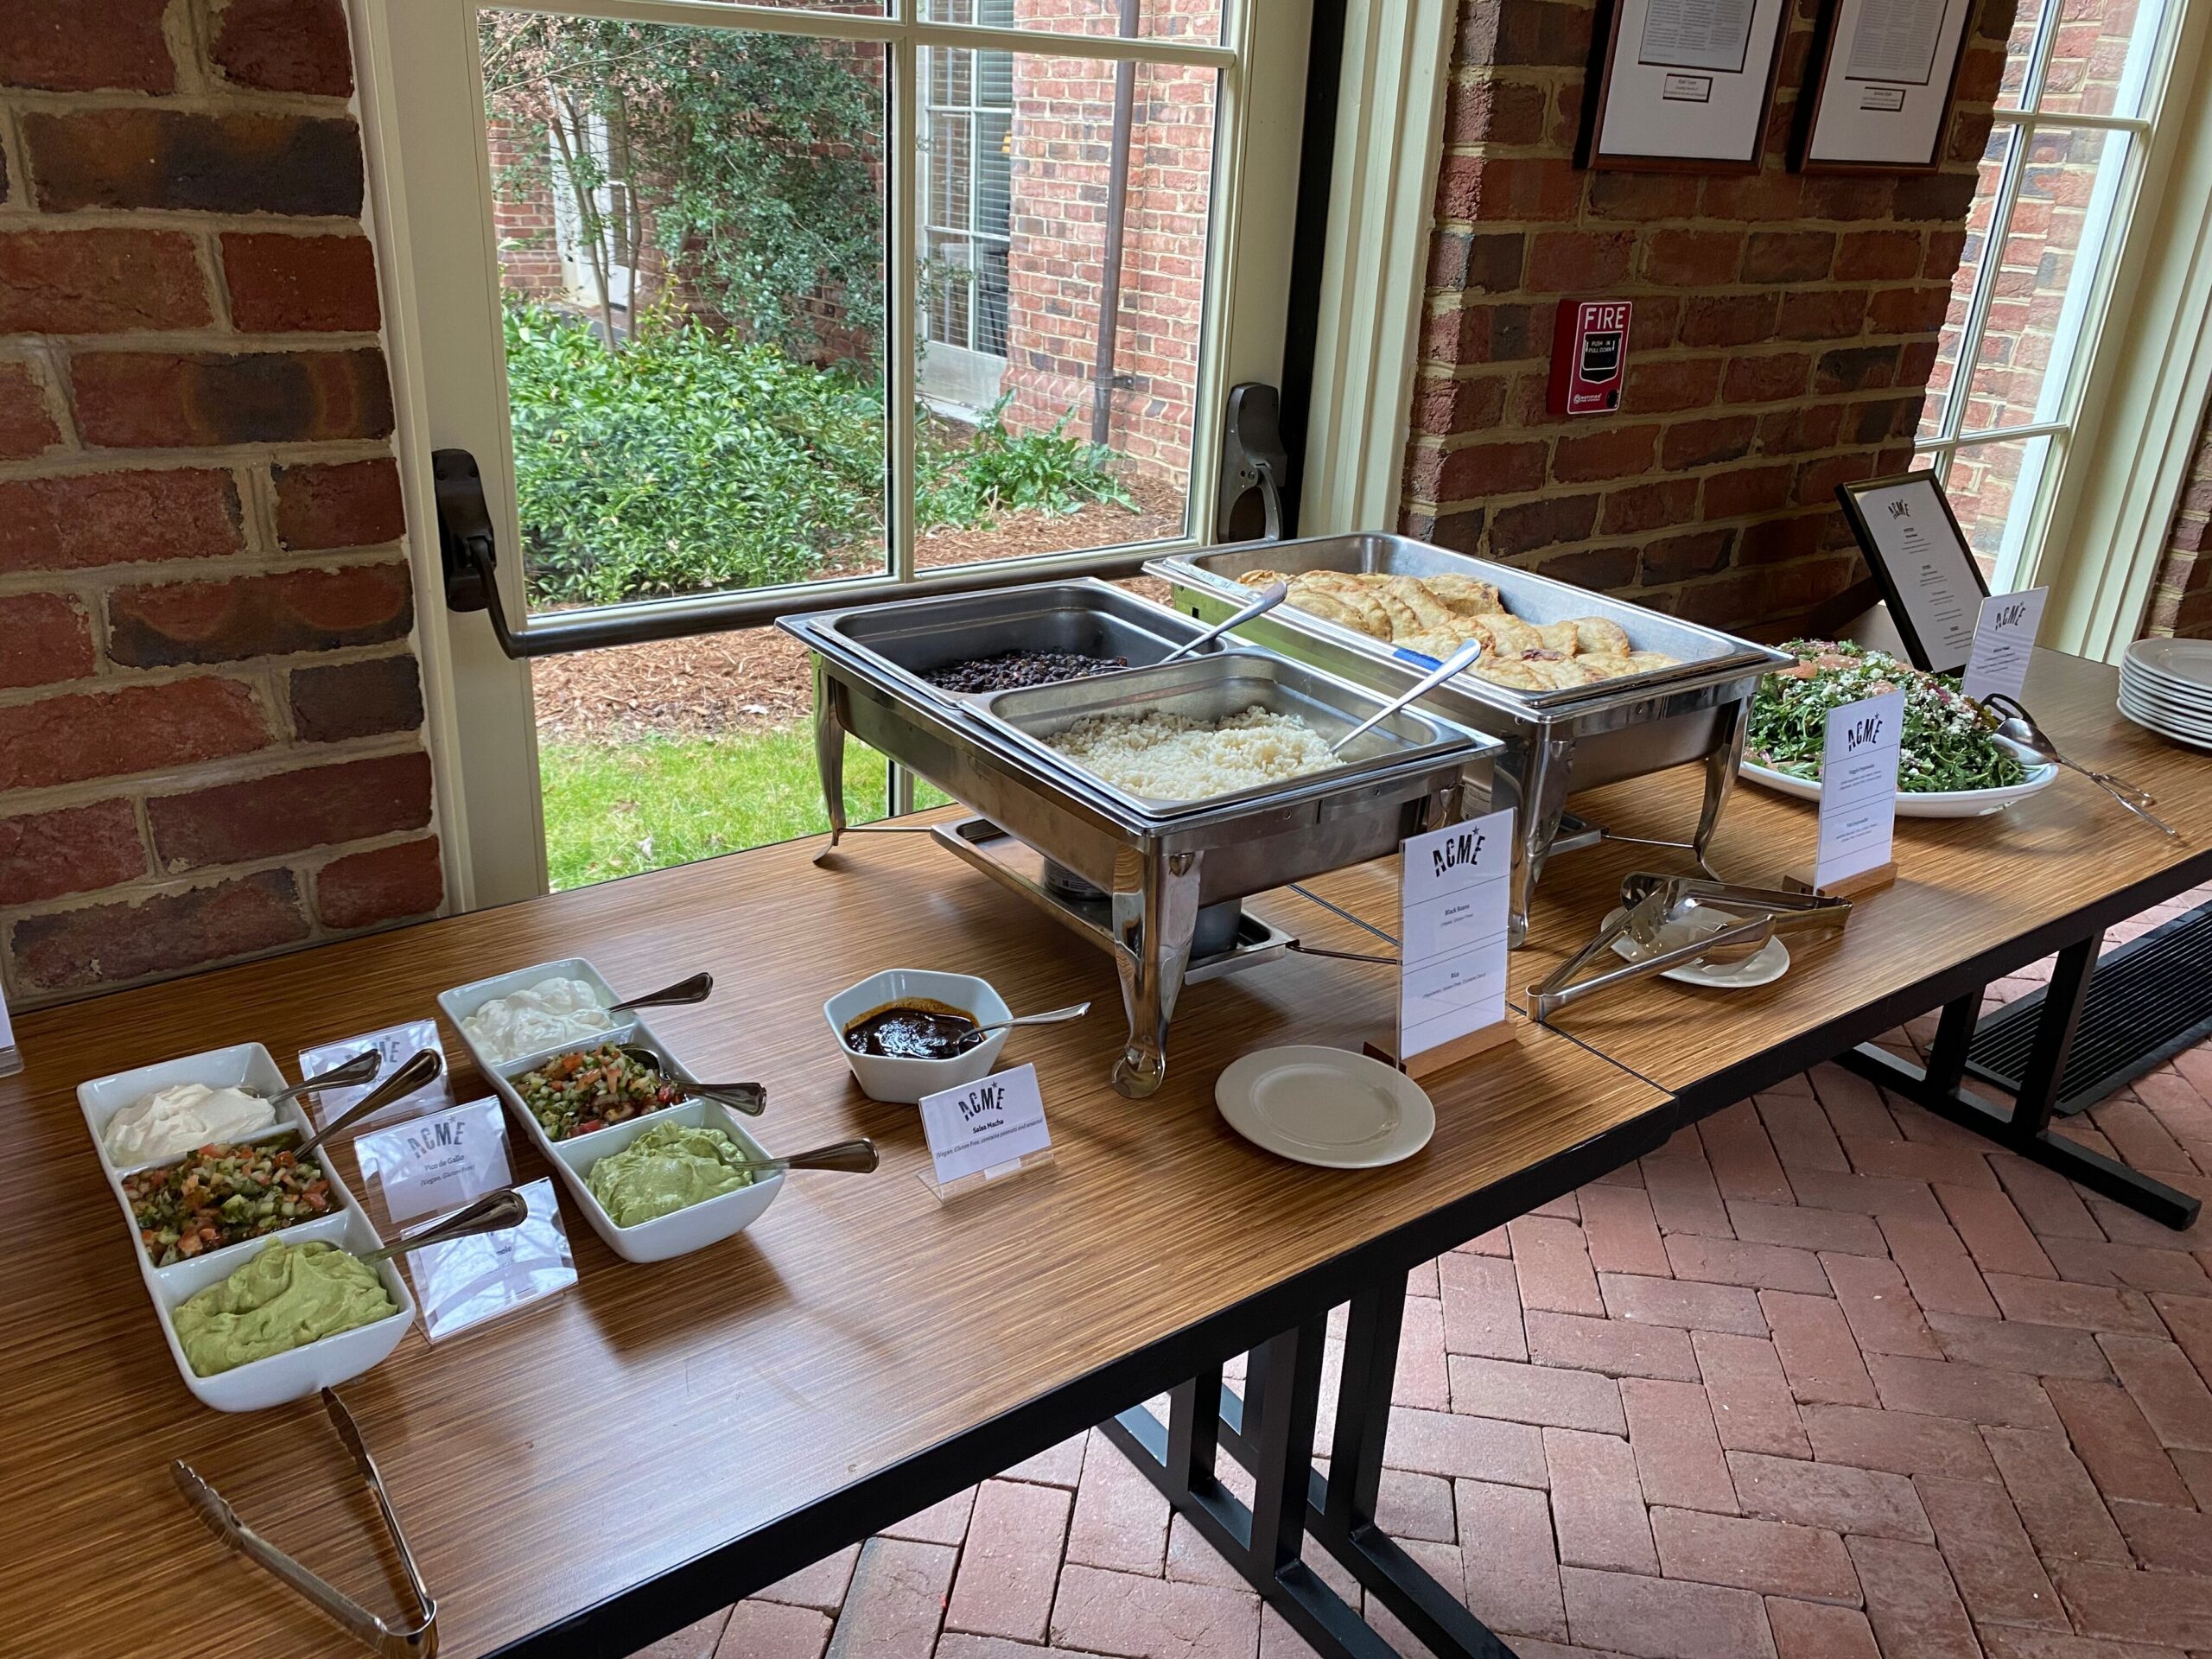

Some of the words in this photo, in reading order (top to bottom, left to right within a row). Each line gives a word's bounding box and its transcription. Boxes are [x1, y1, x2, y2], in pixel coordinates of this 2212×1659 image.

[1585, 307, 1625, 329] FIRE
[1888, 501, 1910, 519] ACME
[1995, 605, 2025, 631] ACME
[1847, 718, 1883, 753] ACME
[1433, 834, 1485, 878] ACME
[958, 1087, 1005, 1122] ACME
[972, 1125, 987, 1134] Salsa
[987, 1119, 1004, 1128] Macha
[407, 1122, 465, 1159] ACME
[954, 1143, 969, 1153] Gluten
[424, 1163, 438, 1172] Pico
[447, 1154, 465, 1164] Gallo
